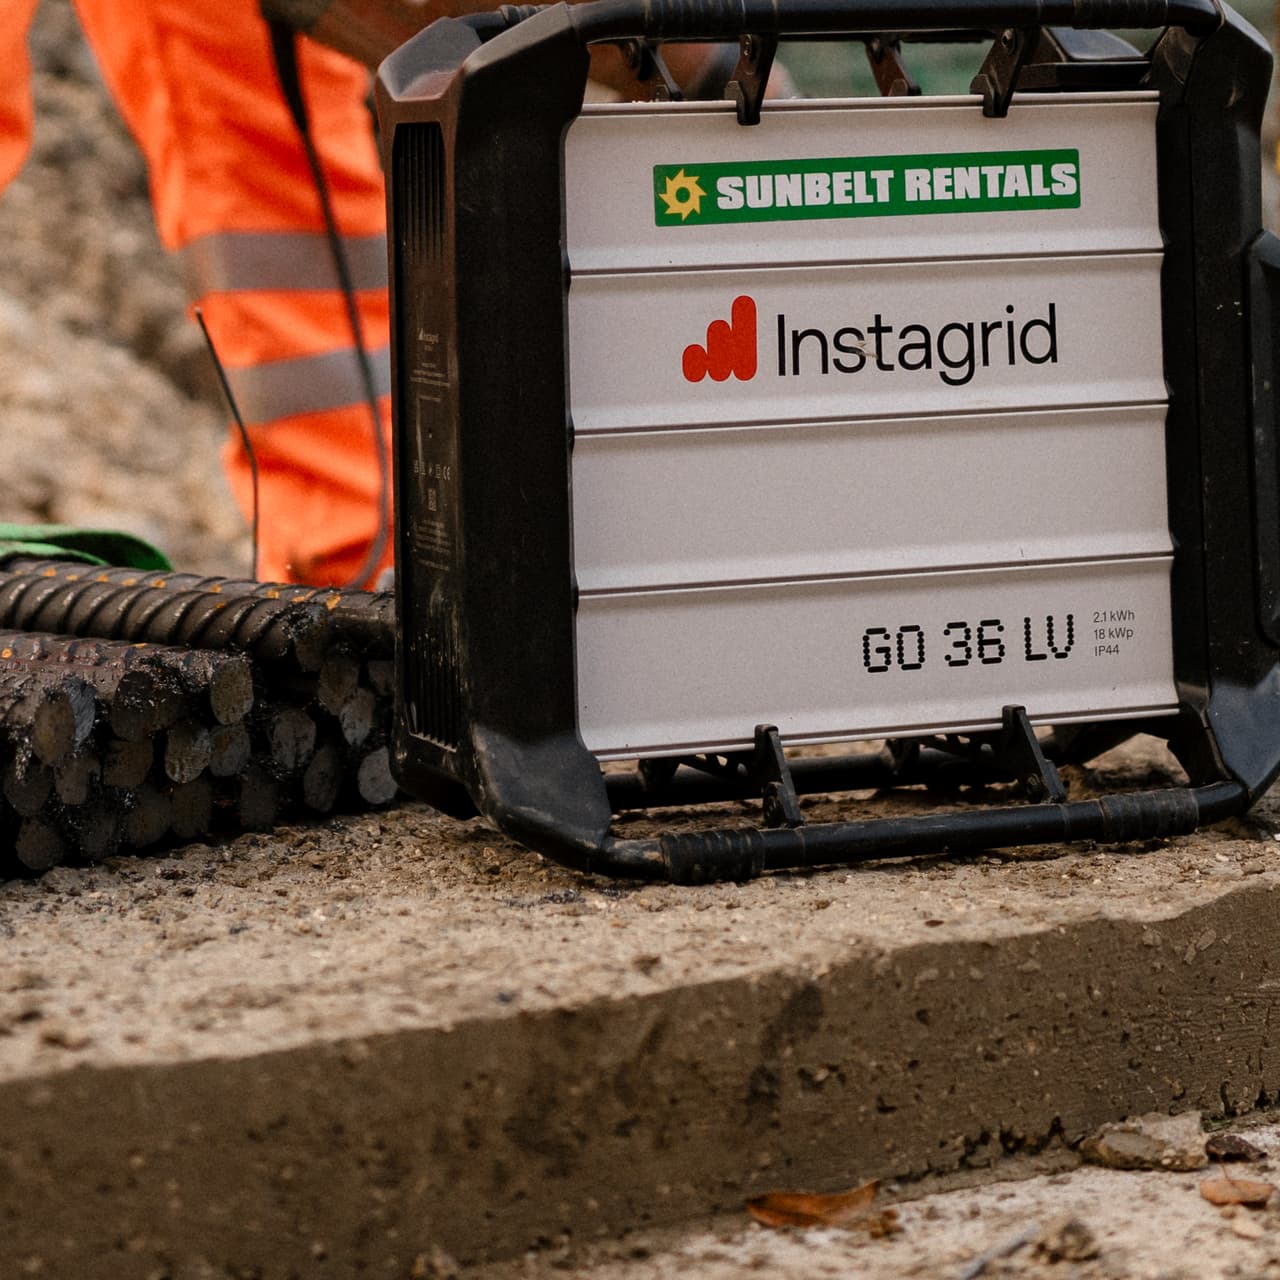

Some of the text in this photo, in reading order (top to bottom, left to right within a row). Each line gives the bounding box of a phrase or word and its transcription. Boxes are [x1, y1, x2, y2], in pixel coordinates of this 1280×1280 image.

[716, 163, 1078, 210] SUNBELT RENTALS
[777, 302, 1058, 387] Instagrid
[1093, 609, 1135, 623] 2.1 kWh
[862, 613, 1075, 674] GO 36 LV
[1093, 627, 1134, 641] 18 kWp
[1094, 644, 1120, 657] IP44
